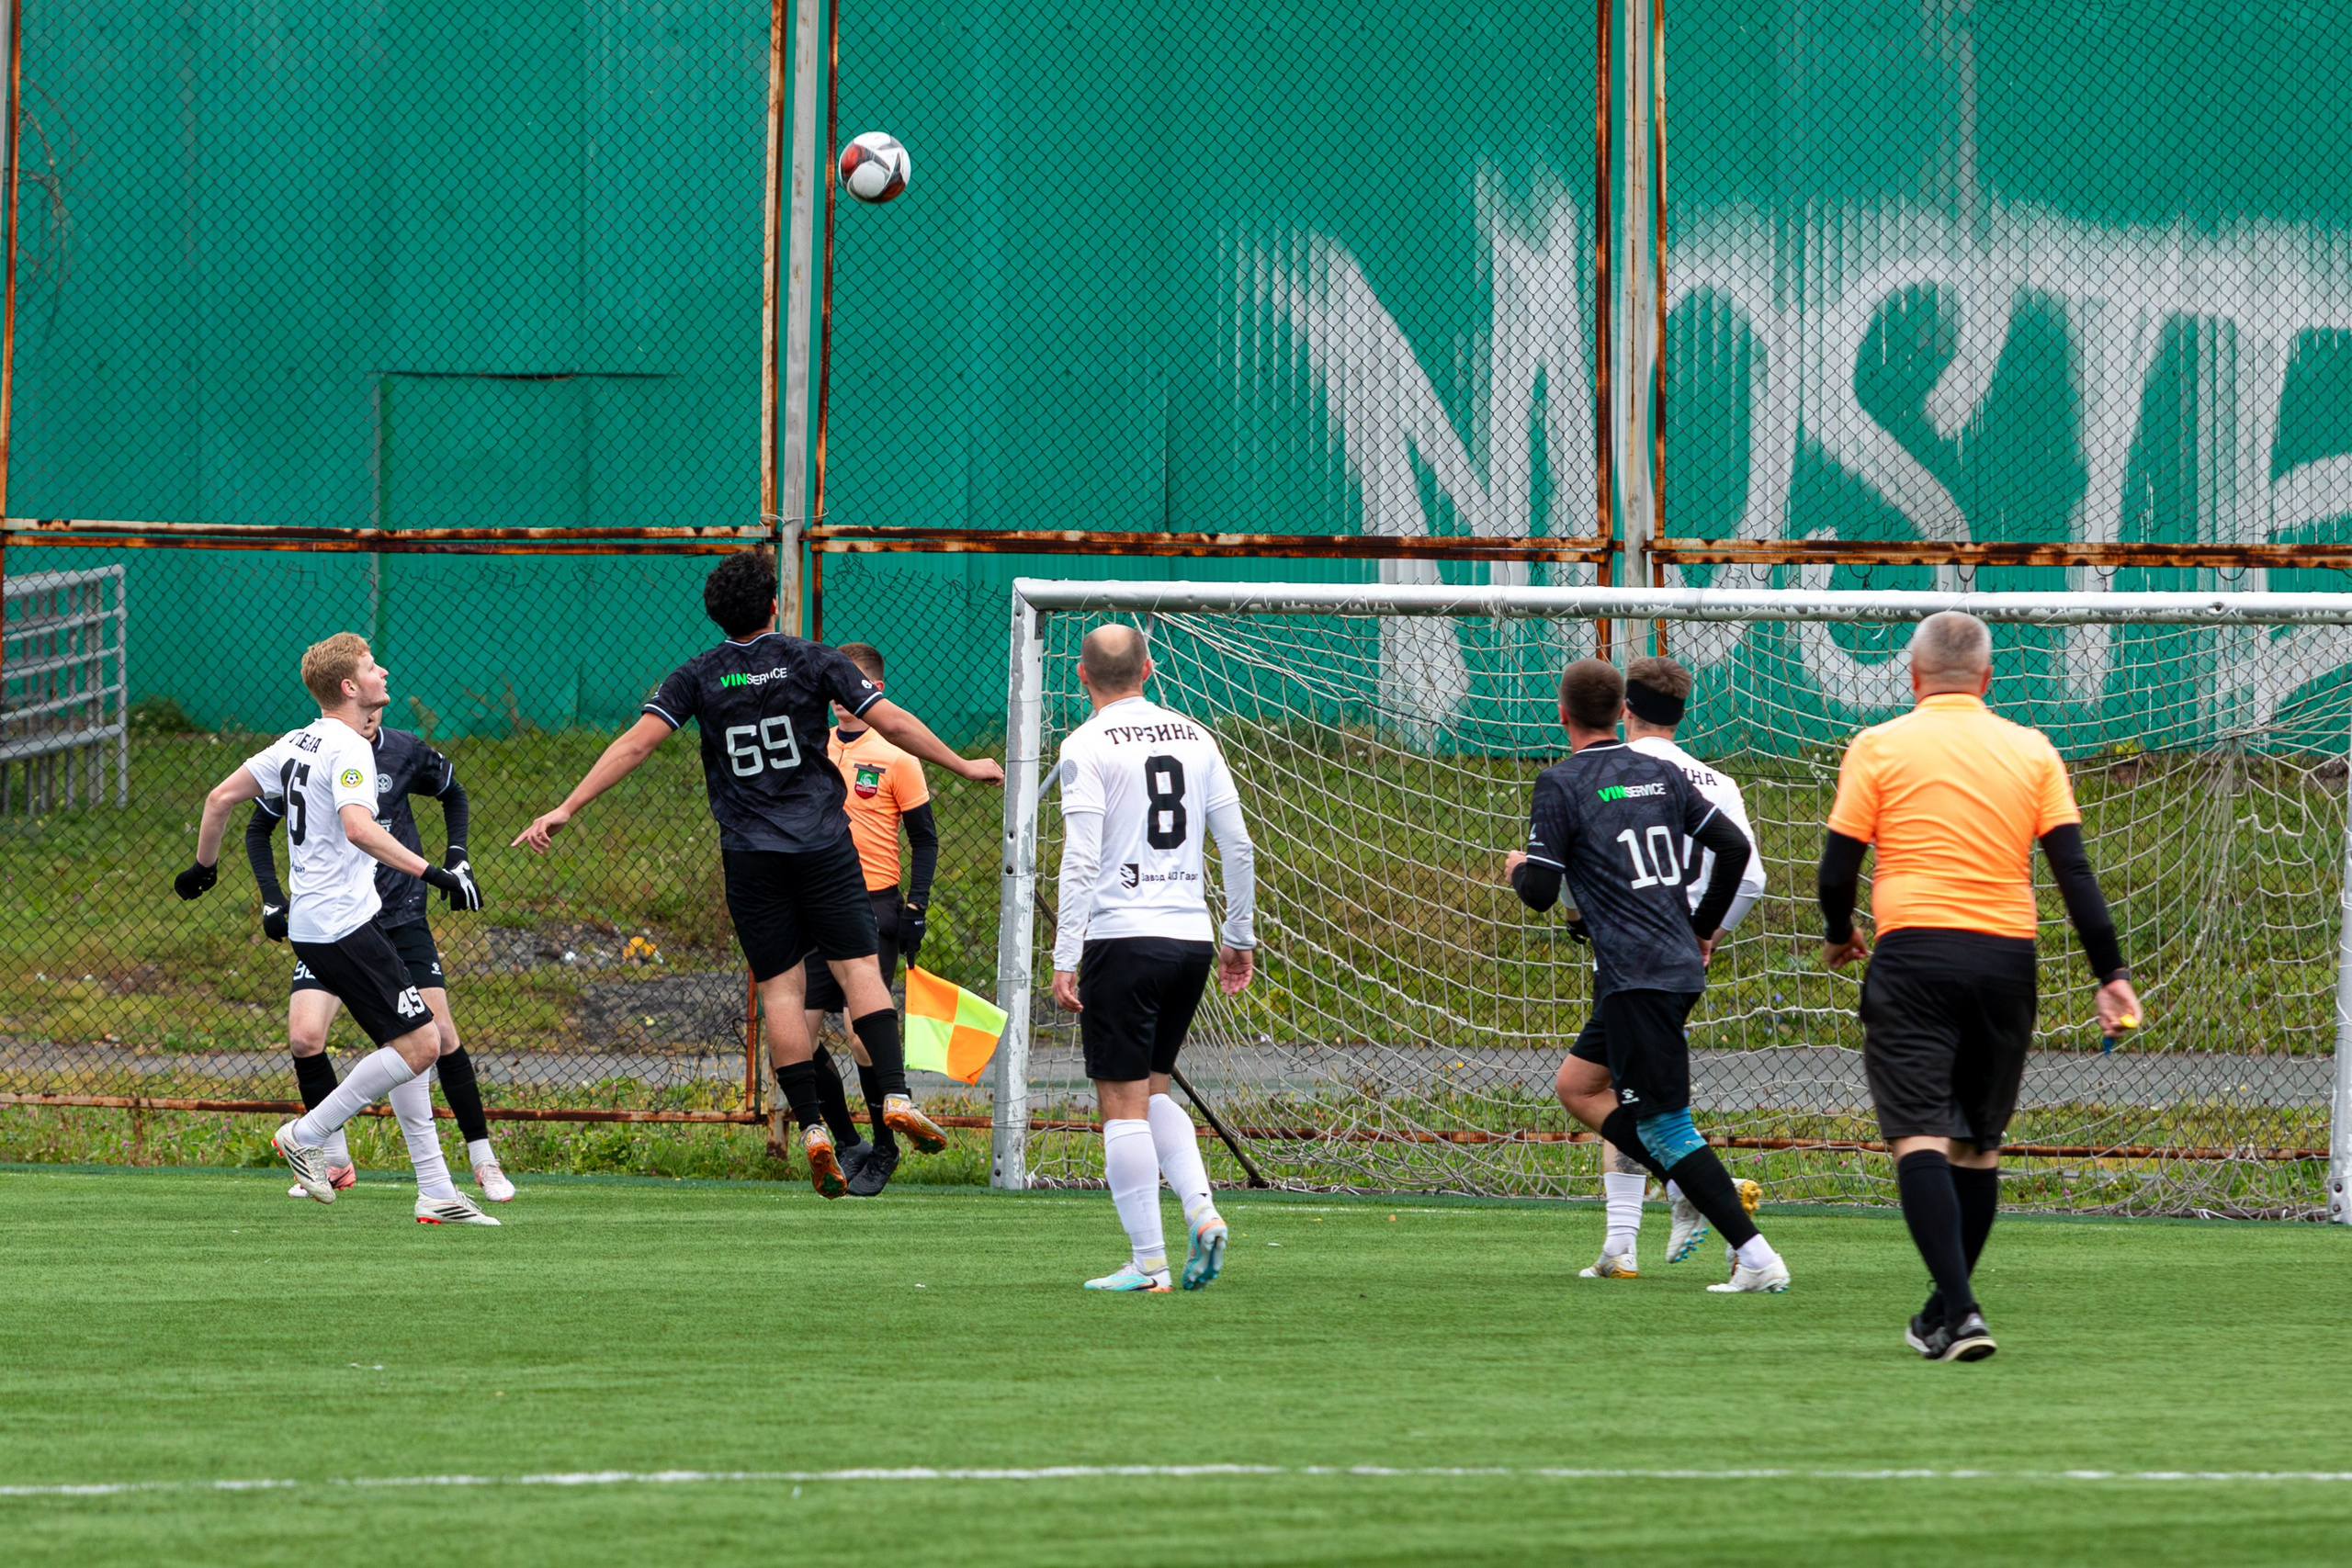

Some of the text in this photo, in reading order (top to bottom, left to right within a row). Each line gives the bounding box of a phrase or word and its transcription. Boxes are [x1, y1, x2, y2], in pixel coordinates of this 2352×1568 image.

[725, 715, 801, 777] 69
[1145, 754, 1186, 851] 8
[1616, 825, 1681, 890] 10
[397, 985, 425, 1019] 45
